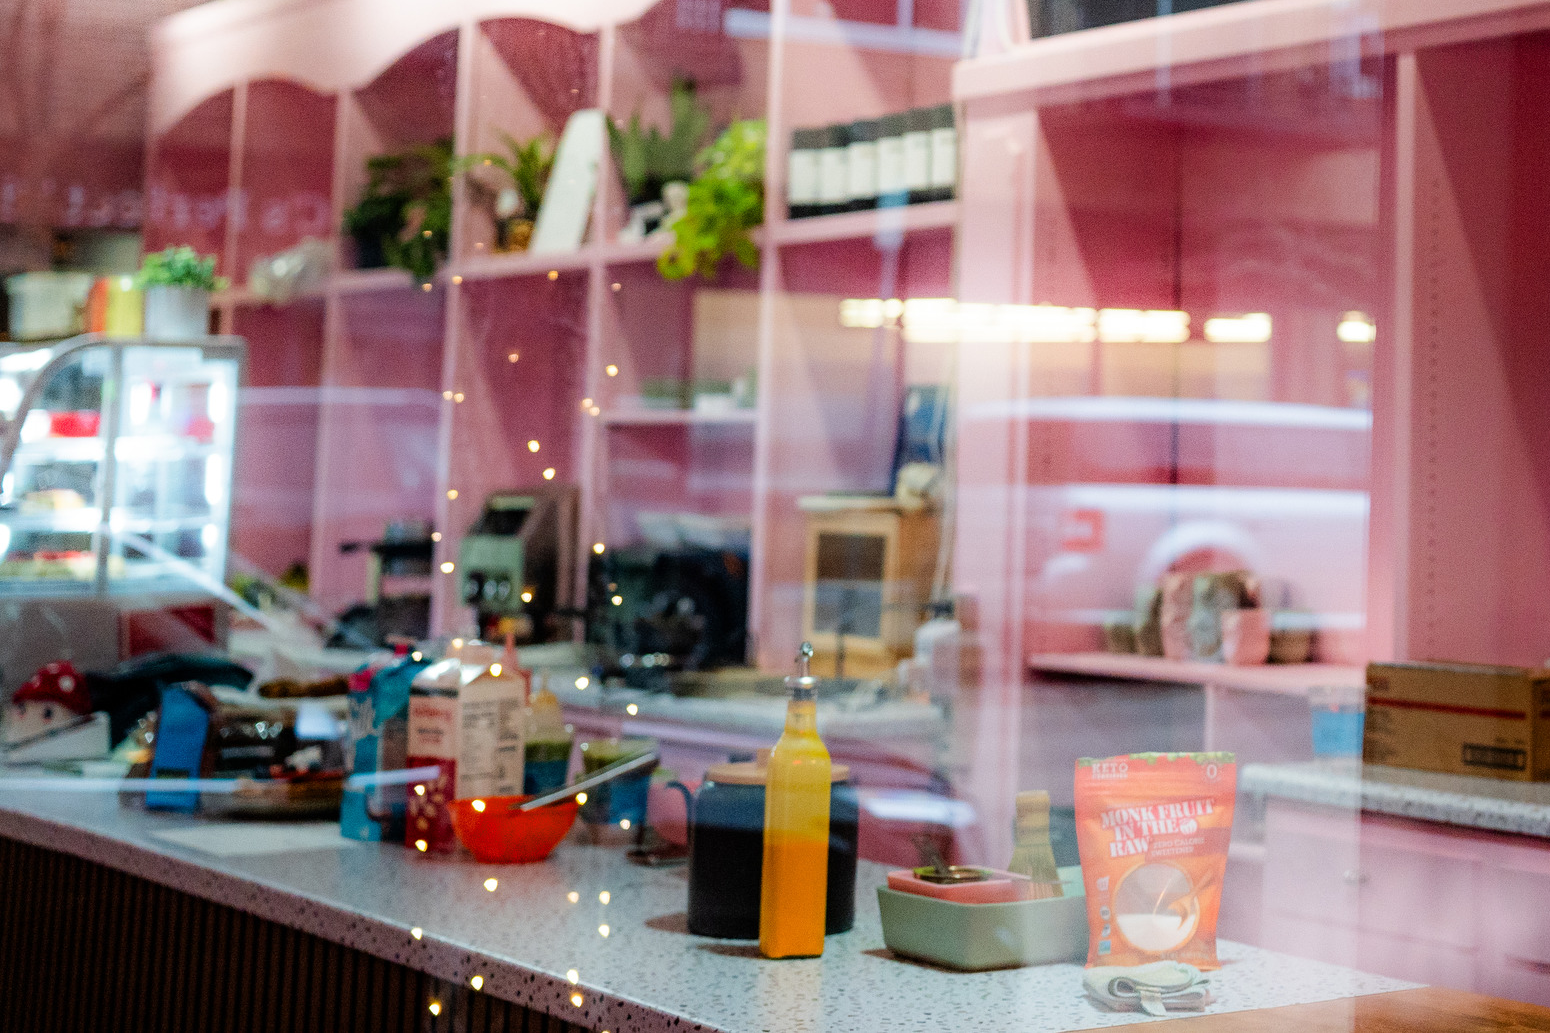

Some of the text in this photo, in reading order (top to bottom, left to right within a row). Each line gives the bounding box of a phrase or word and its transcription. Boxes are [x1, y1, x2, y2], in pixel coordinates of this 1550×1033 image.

[1092, 762, 1129, 774] KETO
[1101, 798, 1215, 829] MONK FRUIT
[1115, 816, 1179, 842] IN THE
[1109, 837, 1150, 858] RAW
